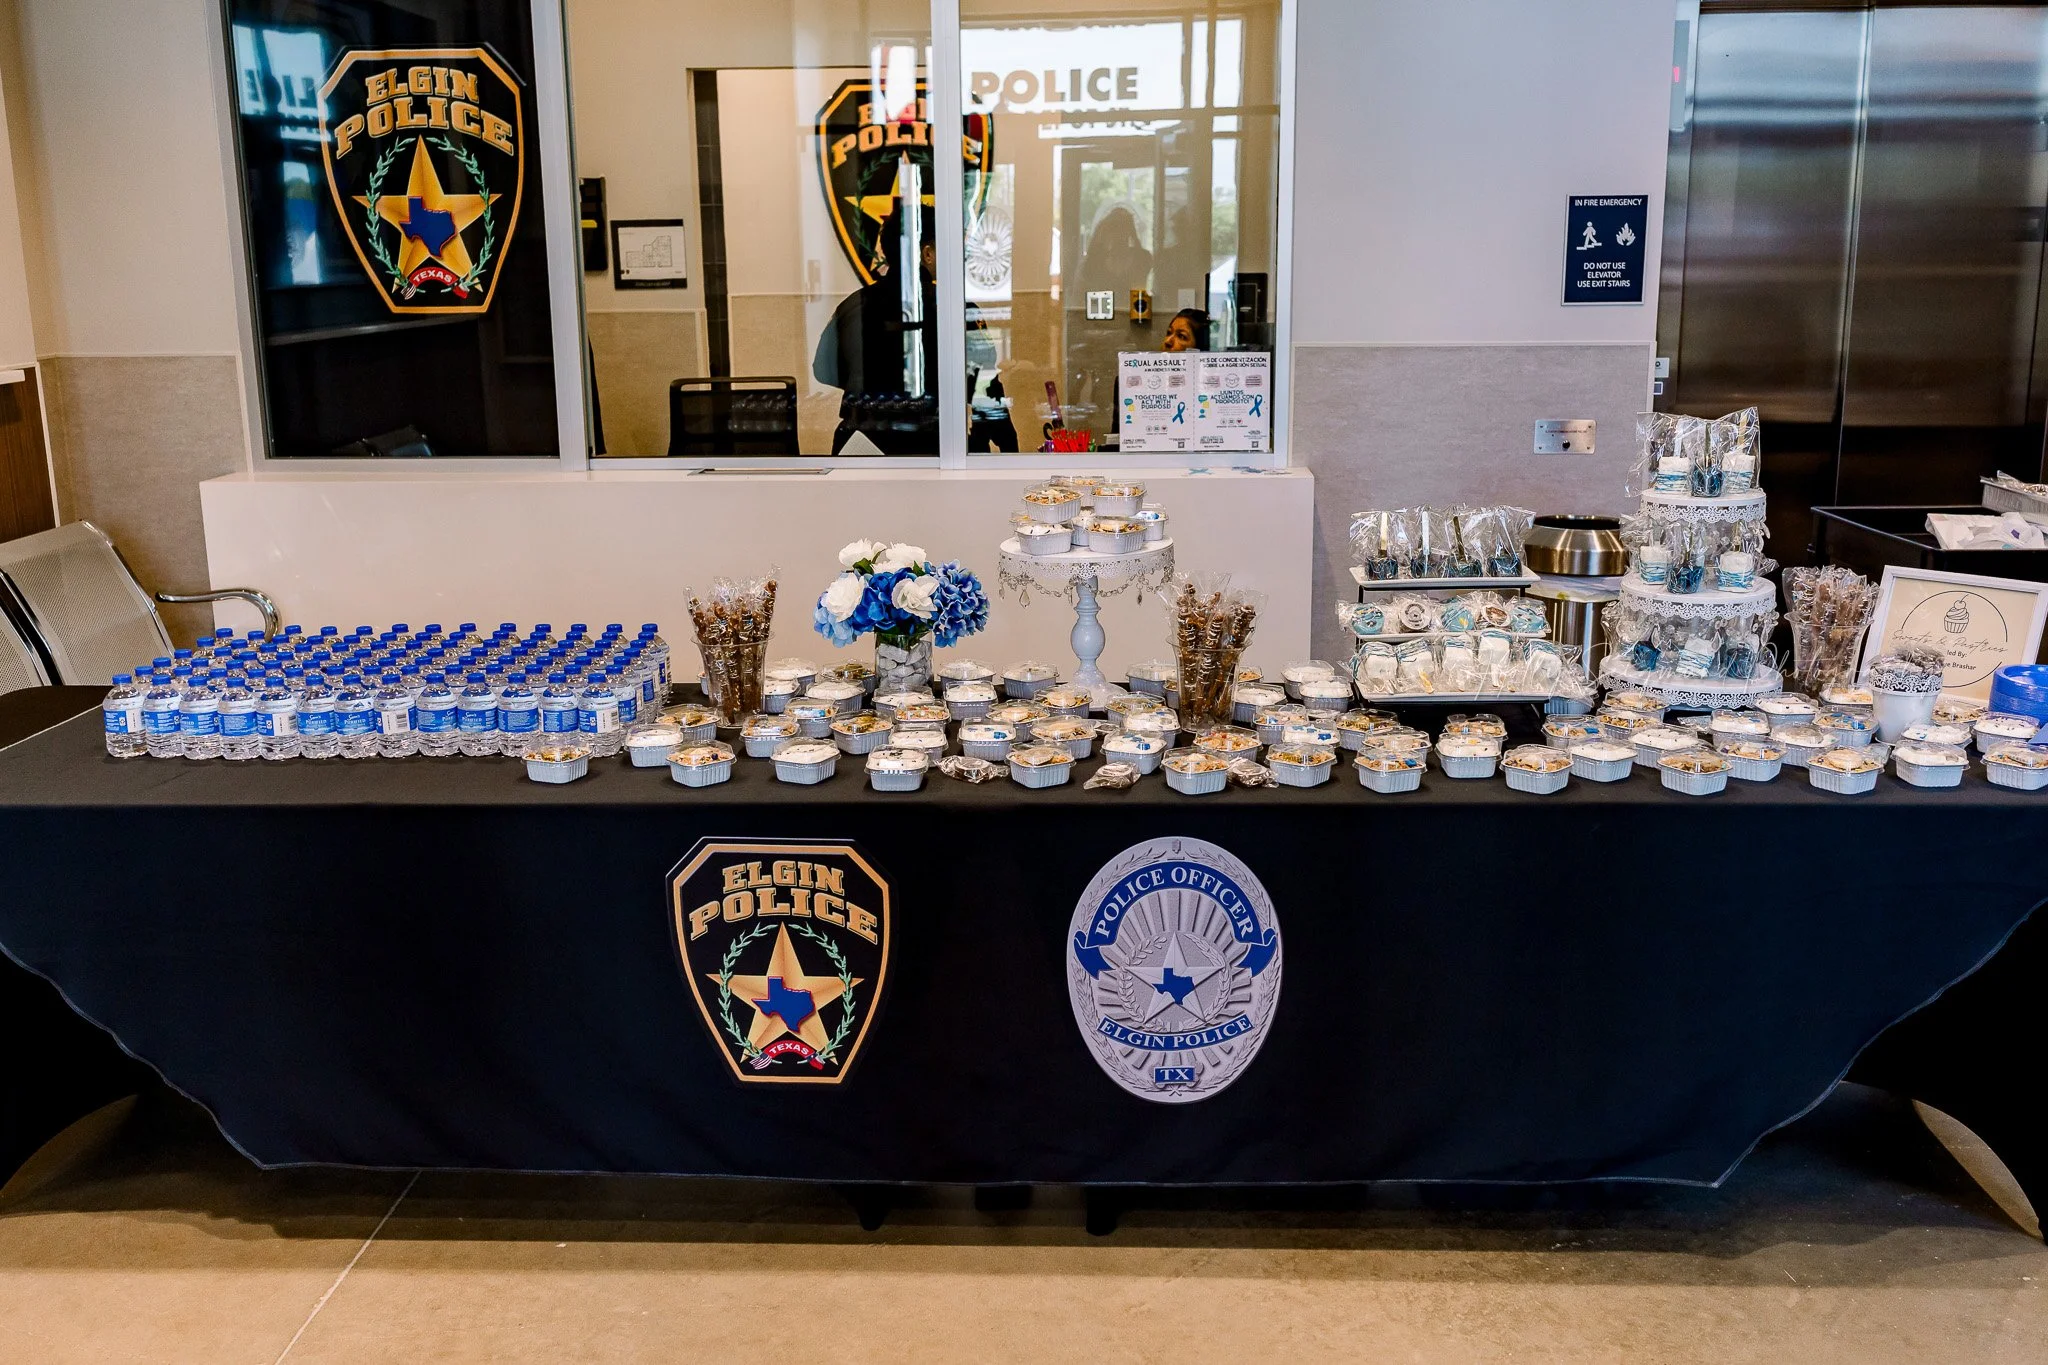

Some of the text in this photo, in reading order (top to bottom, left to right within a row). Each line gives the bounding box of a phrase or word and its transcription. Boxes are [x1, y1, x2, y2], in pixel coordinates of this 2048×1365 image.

[365, 66, 479, 106] ELGIN
[971, 67, 1138, 104] POLICE
[334, 97, 514, 160] POLICE
[1574, 198, 1642, 207] IN FIRE EMERGENCY
[413, 269, 453, 283] TEXAS
[1583, 262, 1595, 270] DO
[1596, 262, 1611, 270] NOT
[1957, 651, 1968, 659] By:
[722, 860, 845, 896] ELGIN
[689, 887, 878, 945] POLICE
[1095, 866, 1255, 938] POLICE OFFICER
[1100, 1015, 1253, 1048] ELGIN POLICE
[768, 1042, 810, 1056] TEXAS
[1159, 1068, 1190, 1081] TX
